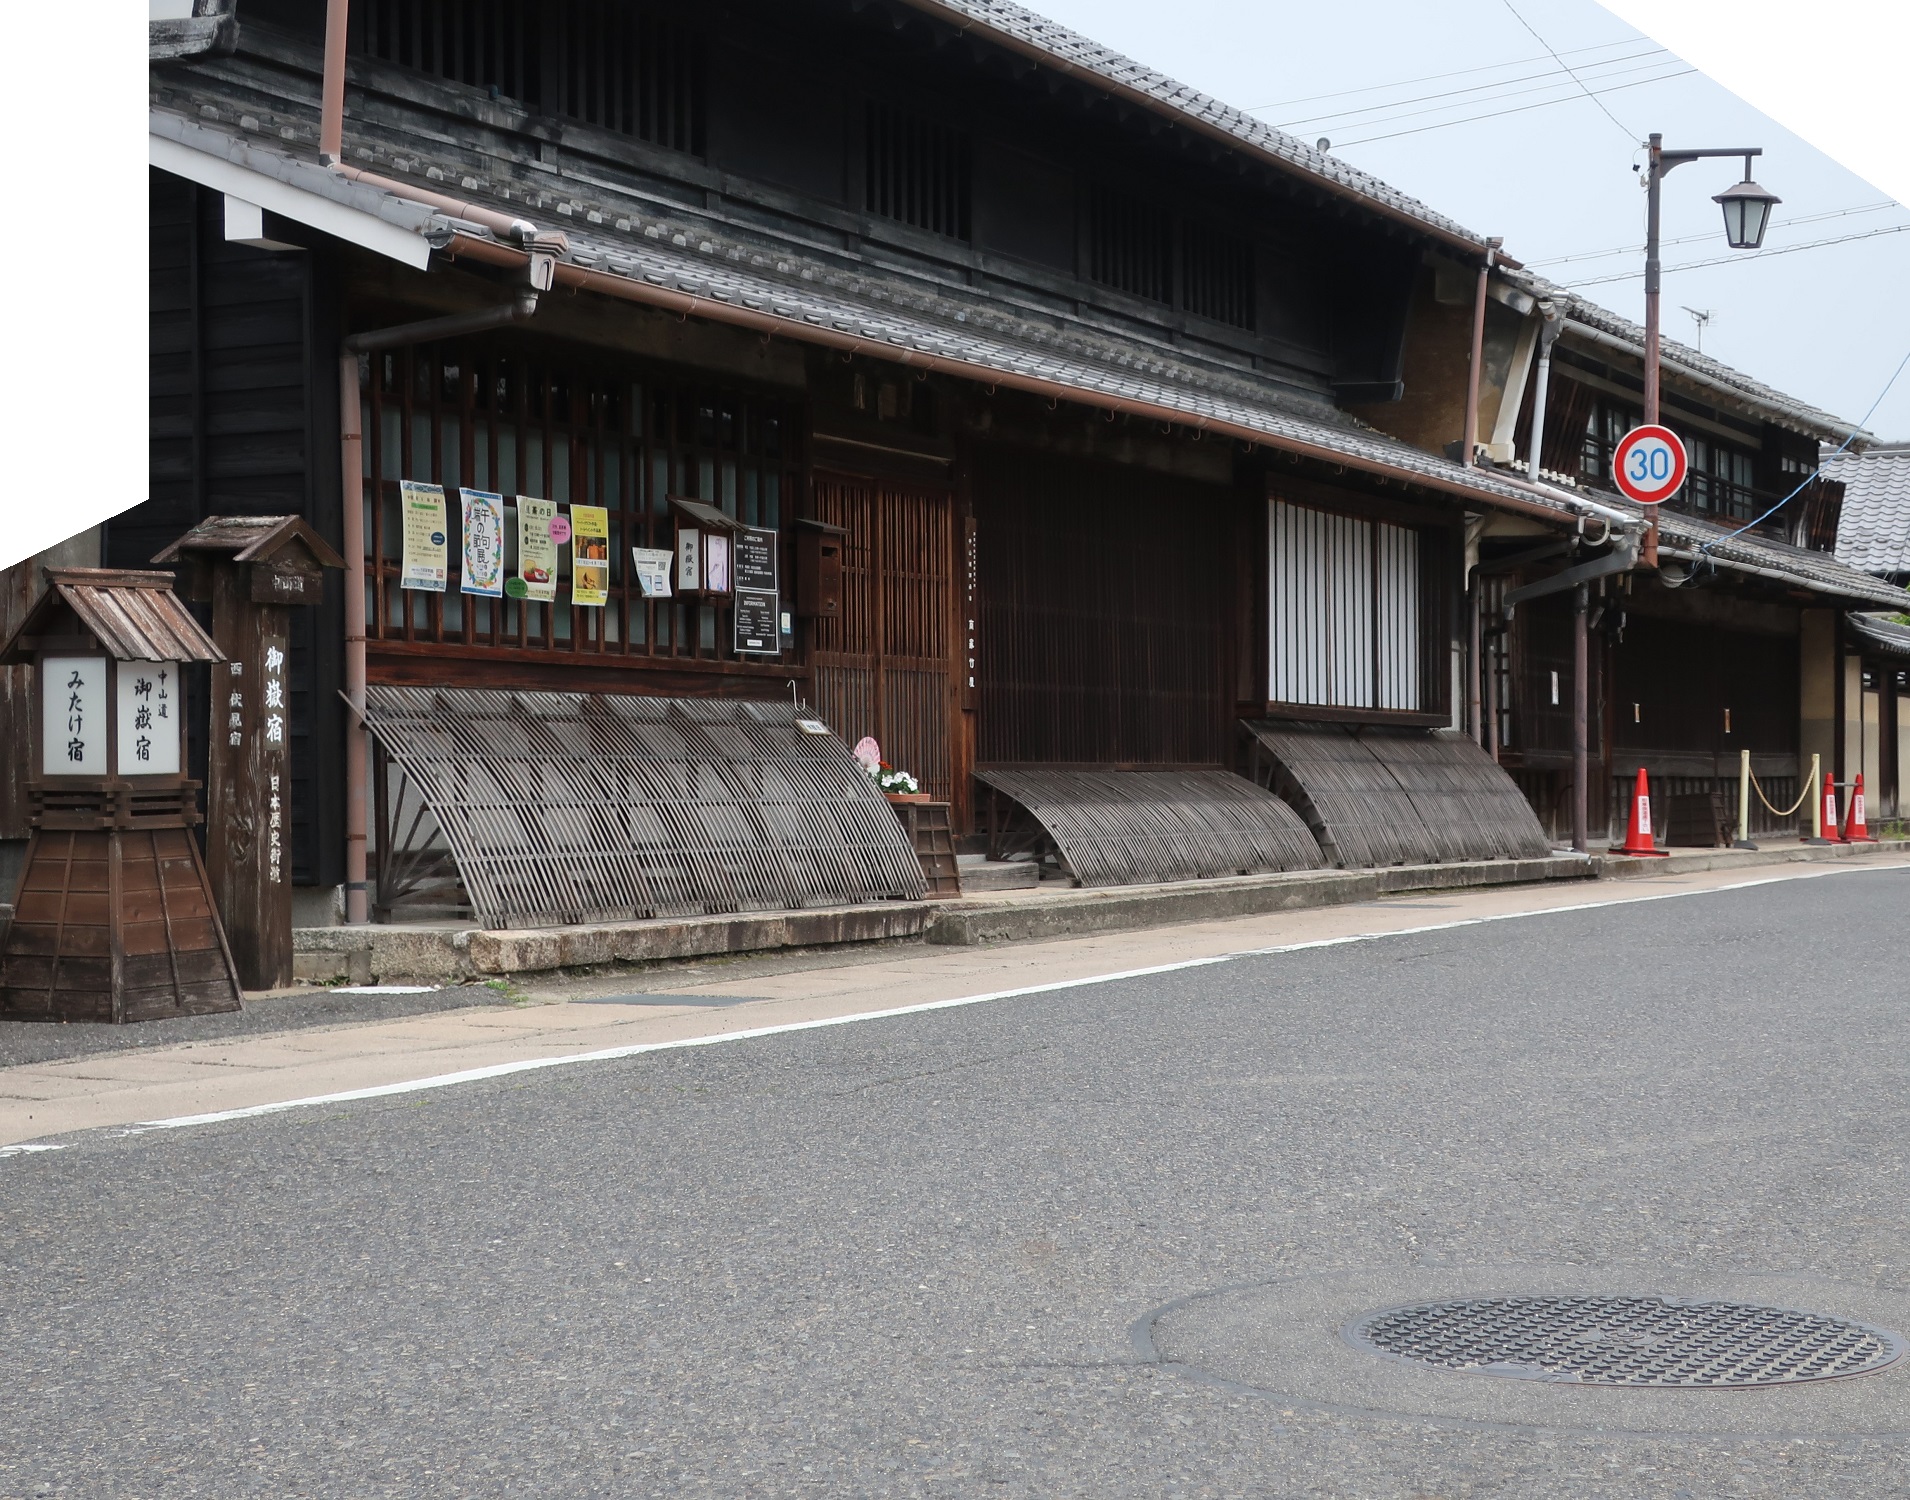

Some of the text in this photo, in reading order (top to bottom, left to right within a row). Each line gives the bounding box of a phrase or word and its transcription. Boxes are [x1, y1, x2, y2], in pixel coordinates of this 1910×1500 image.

[1630, 447, 1669, 481] 30
[157, 669, 168, 719] 中山道
[230, 661, 243, 676] 西
[265, 645, 284, 743] 御嶽宿
[67, 670, 85, 762] みたけ宿
[134, 677, 152, 761] 御嶽宿
